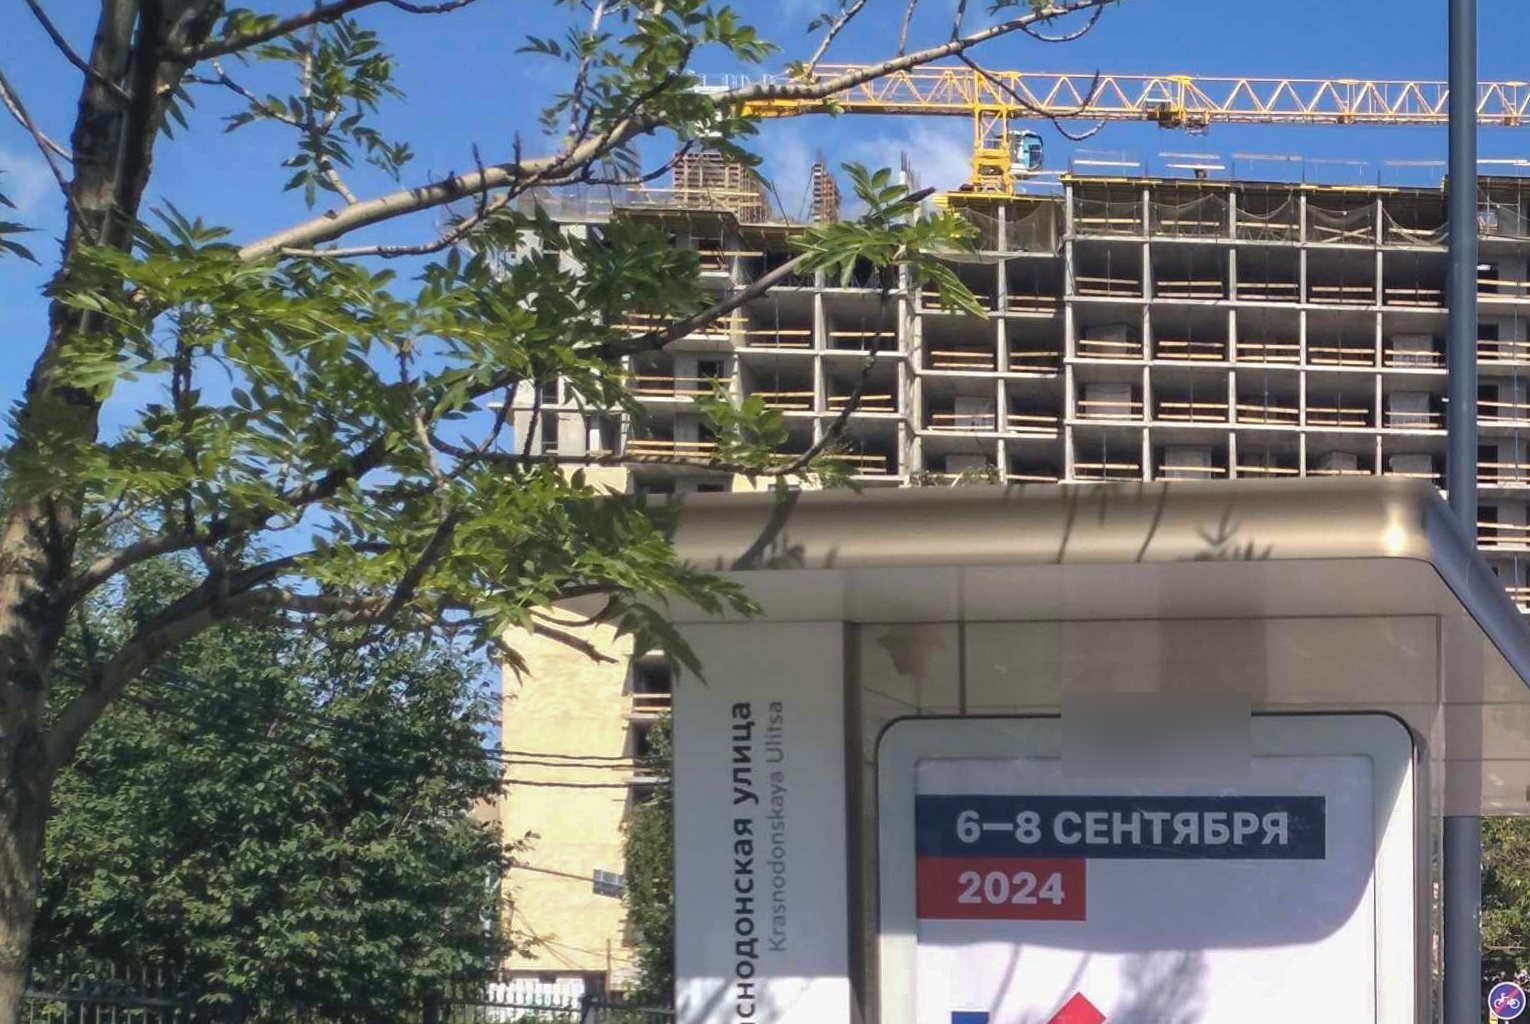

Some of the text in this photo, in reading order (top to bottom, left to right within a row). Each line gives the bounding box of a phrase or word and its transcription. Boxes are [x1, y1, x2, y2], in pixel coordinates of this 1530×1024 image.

[731, 702, 759, 805] улица
[765, 701, 788, 952] Krasnodonskaya Ulitsa
[1053, 811, 1289, 845] СЕНТЯБРЯ
[958, 871, 1066, 905] 2024
